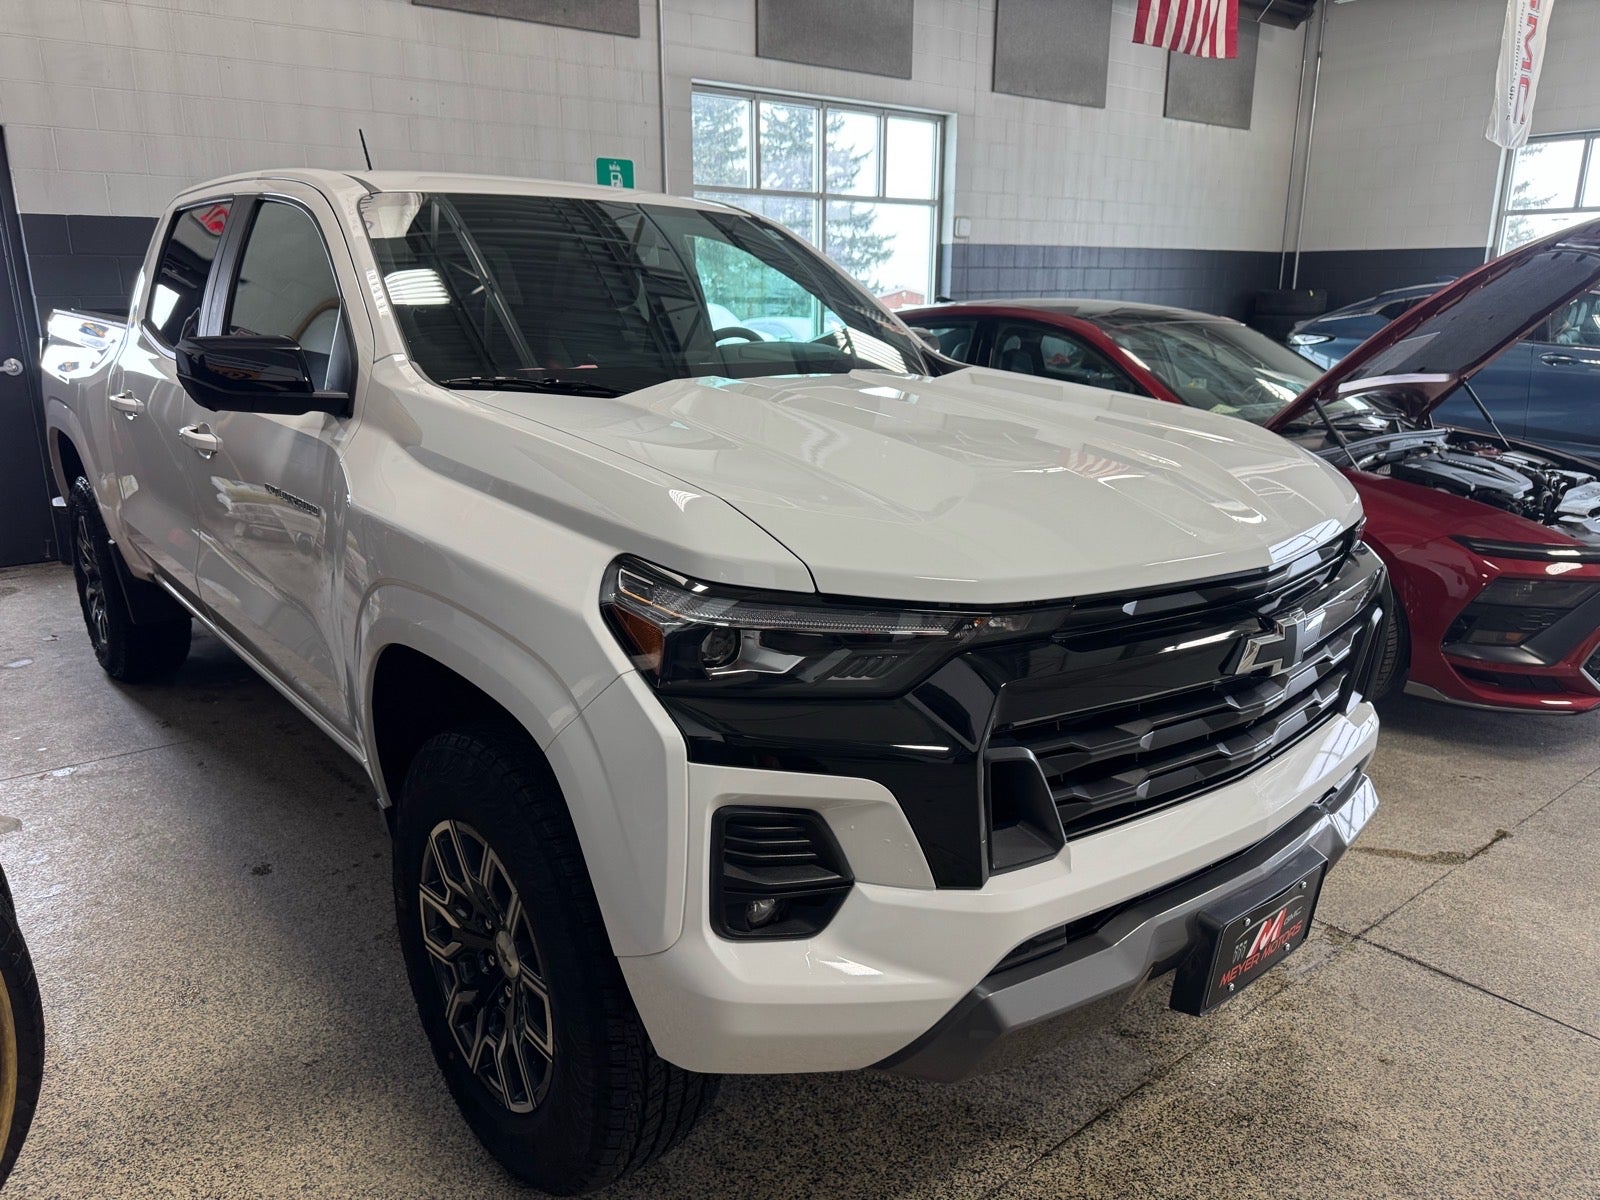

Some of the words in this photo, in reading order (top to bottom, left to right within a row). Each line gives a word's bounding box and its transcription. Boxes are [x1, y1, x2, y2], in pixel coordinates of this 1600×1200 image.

[1284, 906, 1303, 926] GMC
[1219, 952, 1260, 988] MEYER
[1261, 919, 1303, 960] MOTORS
